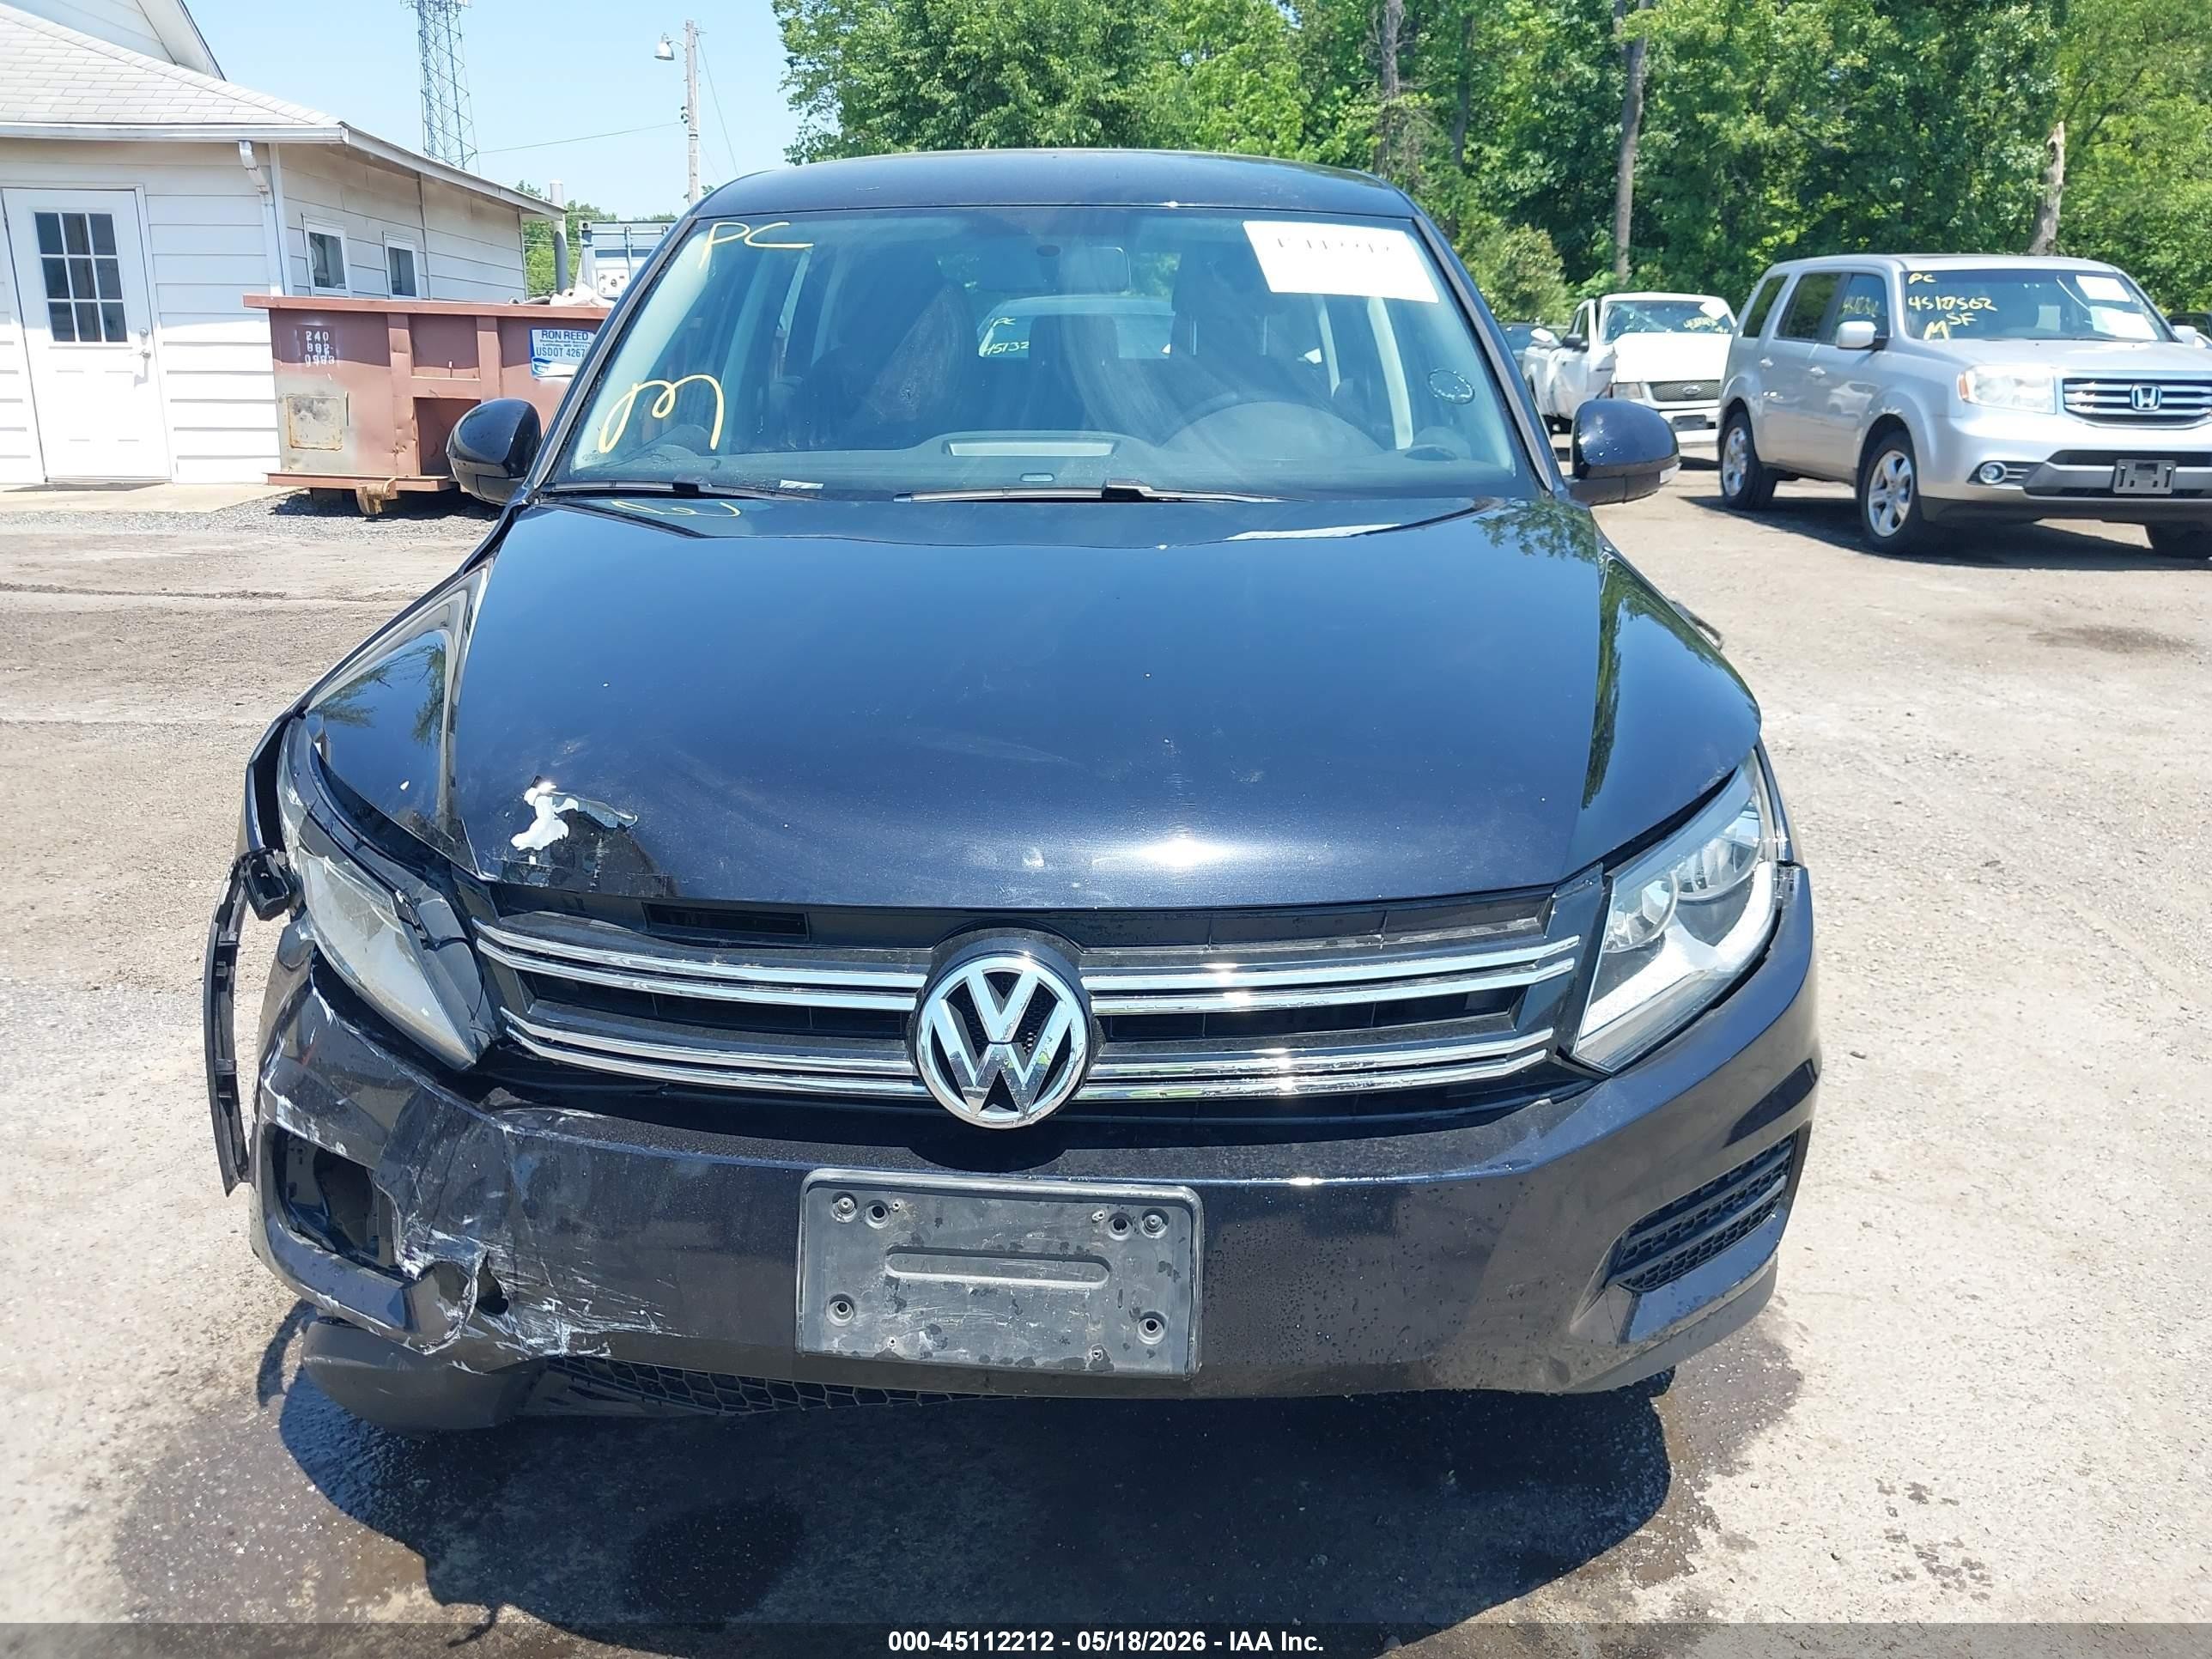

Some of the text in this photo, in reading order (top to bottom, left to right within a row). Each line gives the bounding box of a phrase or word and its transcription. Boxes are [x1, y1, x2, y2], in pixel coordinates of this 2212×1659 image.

[698, 222, 815, 269] PC
[1908, 272, 1937, 284] PC
[1946, 311, 1978, 326] SF
[541, 330, 589, 341] RON REED
[1923, 320, 1950, 340] M
[536, 346, 563, 357] USDOT
